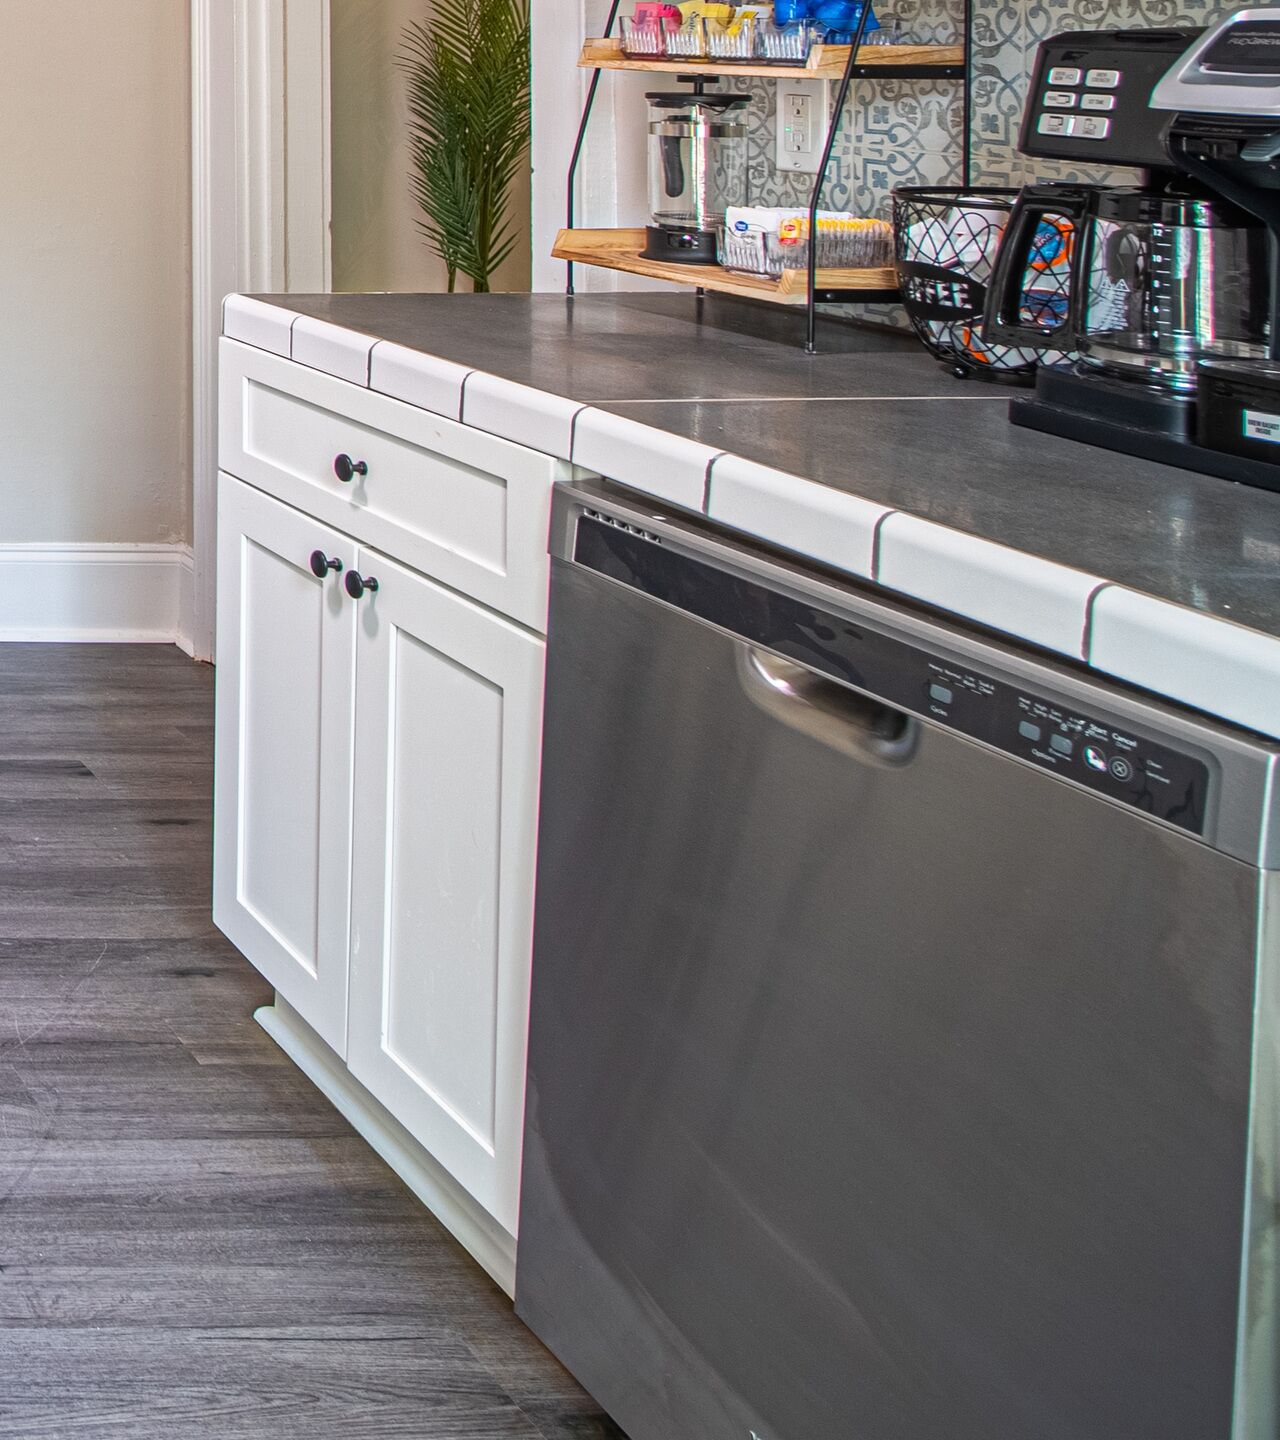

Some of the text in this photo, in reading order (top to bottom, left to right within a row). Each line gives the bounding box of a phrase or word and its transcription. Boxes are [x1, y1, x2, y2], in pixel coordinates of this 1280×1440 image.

[1152, 255, 1163, 263] 10
[1089, 724, 1108, 735] Start
[1112, 733, 1138, 748] Cancel
[1031, 748, 1057, 763] Options
